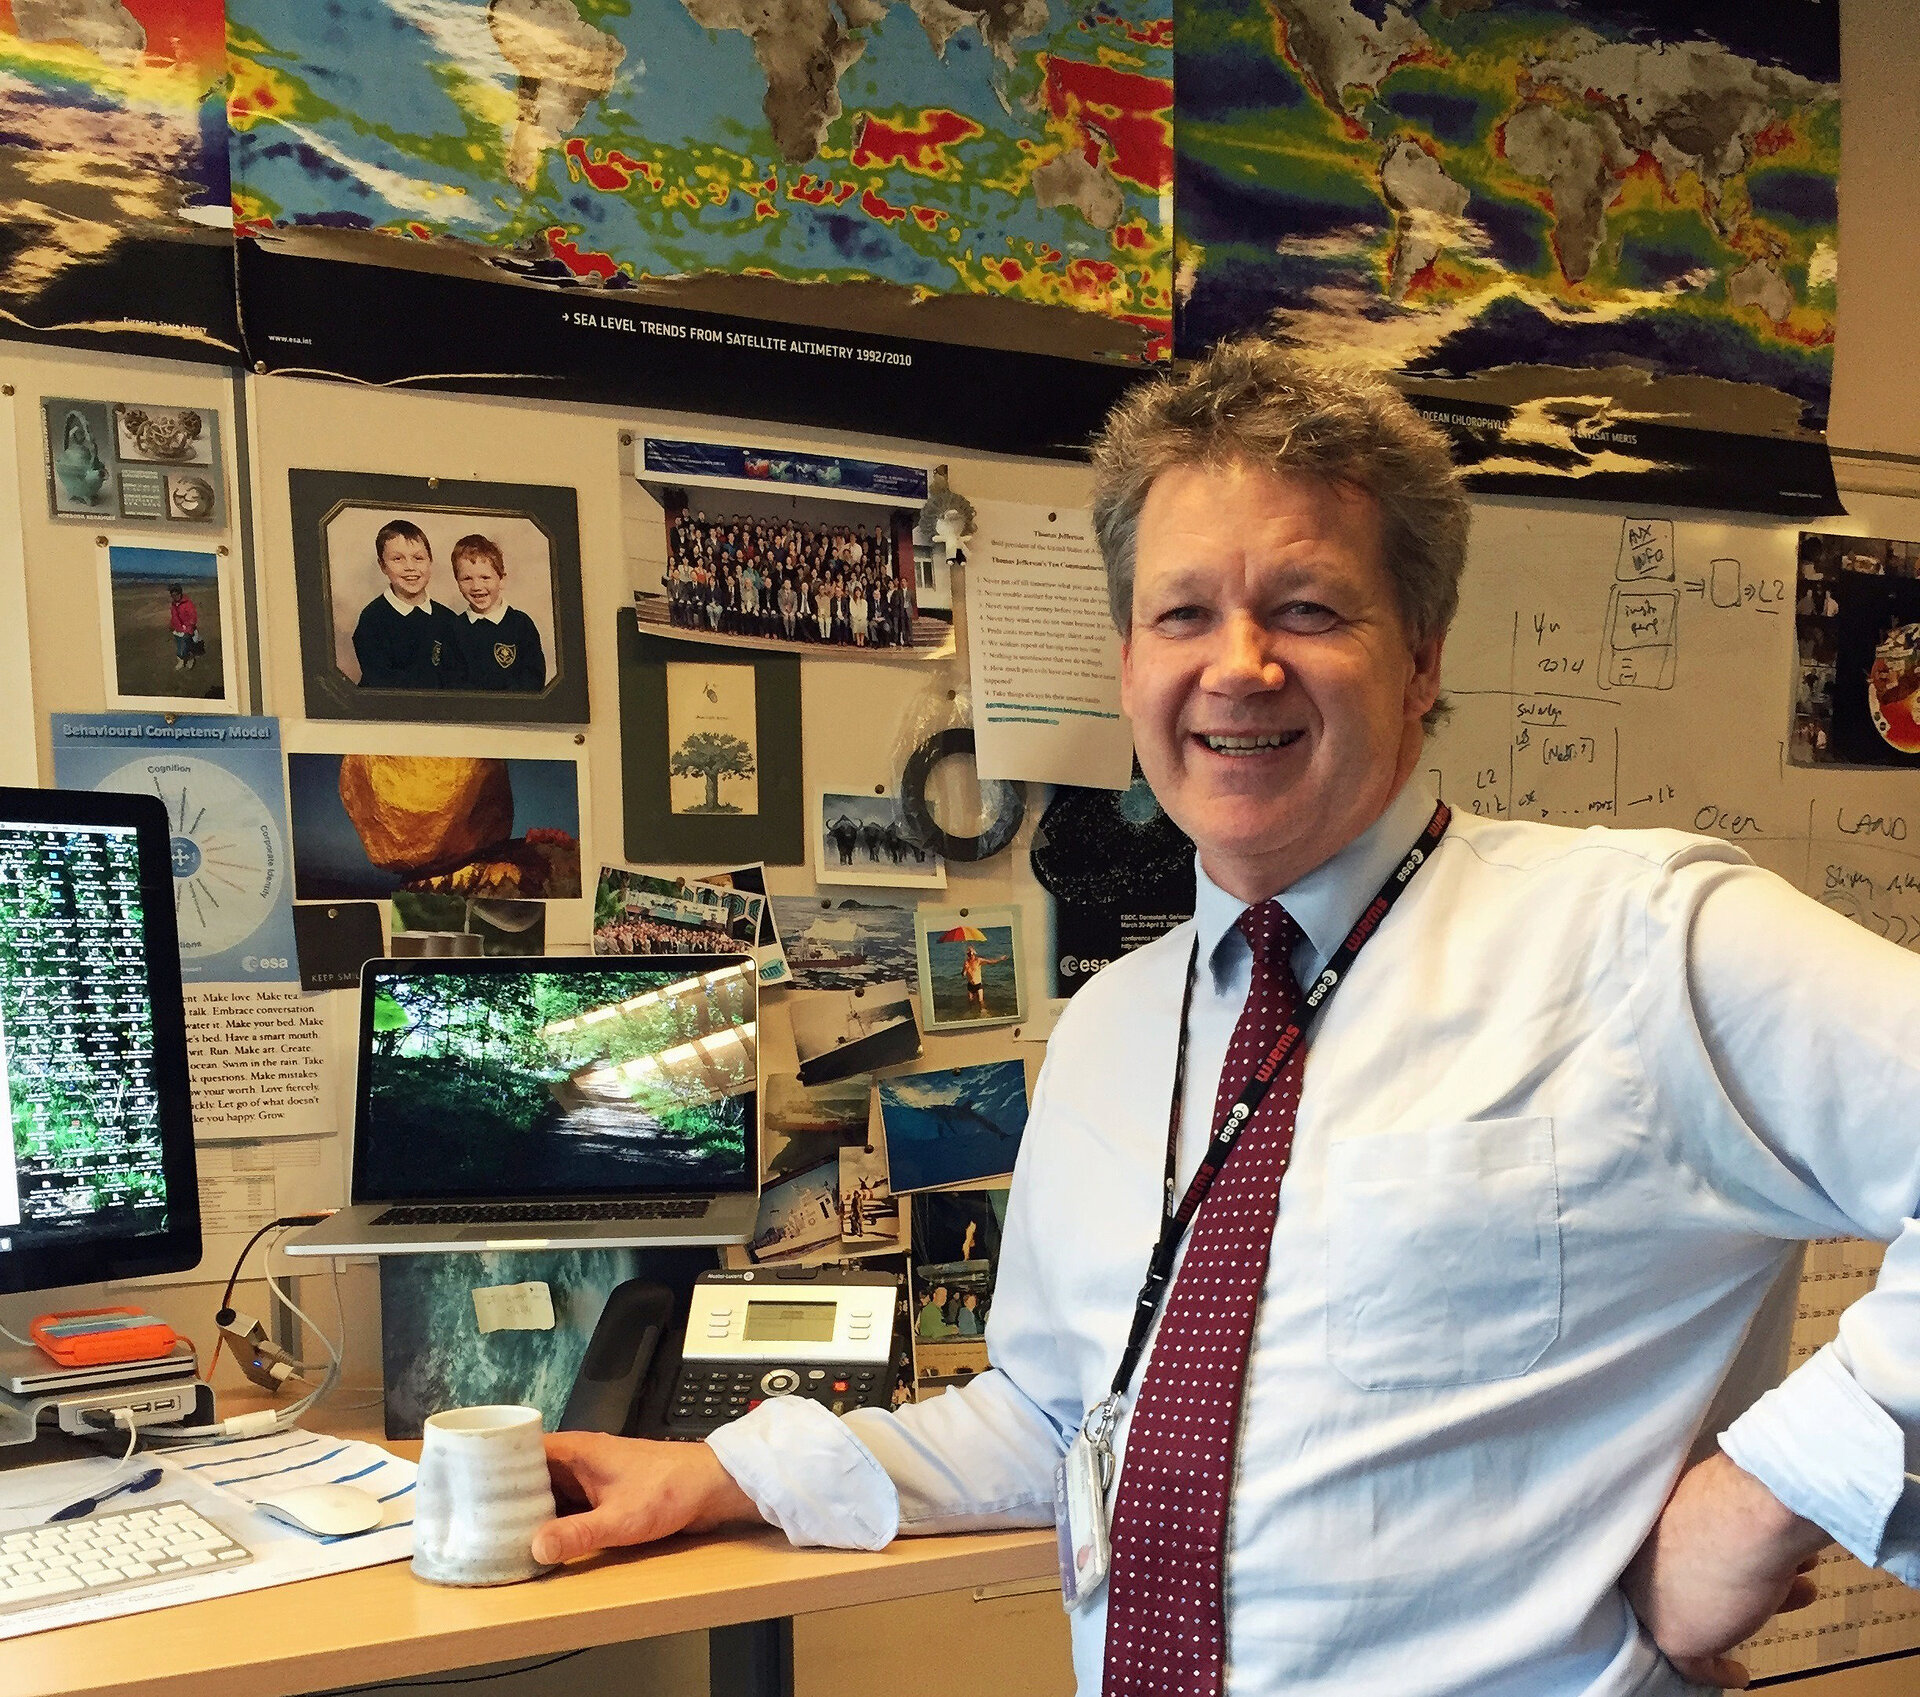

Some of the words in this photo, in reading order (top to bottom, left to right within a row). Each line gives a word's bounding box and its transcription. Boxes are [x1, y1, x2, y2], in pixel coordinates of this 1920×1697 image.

[268, 334, 312, 346] www.esa.int
[573, 312, 597, 328] SEA
[600, 315, 637, 333] LEVEL
[639, 320, 687, 339] TRENDS
[690, 327, 723, 343] FROM
[726, 332, 787, 352] SATELLITE
[789, 340, 853, 359] ALTIMETRY
[856, 348, 912, 367] 1992/2010
[1422, 410, 1450, 424] OCEAN
[1451, 413, 1507, 431] CHLOROPHYLL
[1612, 433, 1638, 445] MERIS
[992, 556, 1015, 565] Thomas
[1538, 658, 1585, 674] 2014
[63, 723, 142, 738] Behavioural
[145, 724, 227, 741] Competency
[228, 725, 271, 739] Model
[147, 763, 191, 774] Cognition
[259, 824, 275, 867] Corporate
[259, 867, 275, 899] Identity
[1345, 896, 1389, 952] swarm
[259, 957, 289, 969] esa
[1079, 958, 1110, 973] esa
[311, 973, 334, 983] KEEP
[202, 993, 228, 1003] Make
[256, 991, 282, 1001] Make
[212, 1006, 254, 1016] Embrace
[225, 1019, 251, 1028] Make
[253, 1020, 275, 1030] your
[299, 1017, 324, 1027] Make
[225, 1032, 250, 1042] Have
[259, 1033, 286, 1041] smart
[234, 1045, 260, 1055] Make
[1255, 1023, 1300, 1082] swarm
[222, 1060, 249, 1069] Swim
[262, 1058, 278, 1067] the
[301, 1056, 324, 1065] Take
[250, 1071, 276, 1081] Make
[203, 1089, 225, 1098] your
[260, 1084, 283, 1093] Love
[218, 1101, 234, 1109] Let
[236, 1102, 248, 1110] go
[250, 1097, 261, 1107] of
[262, 1097, 285, 1106] what
[287, 1095, 320, 1105] doesn't
[206, 1115, 225, 1125] you
[1219, 1117, 1240, 1144] esa
